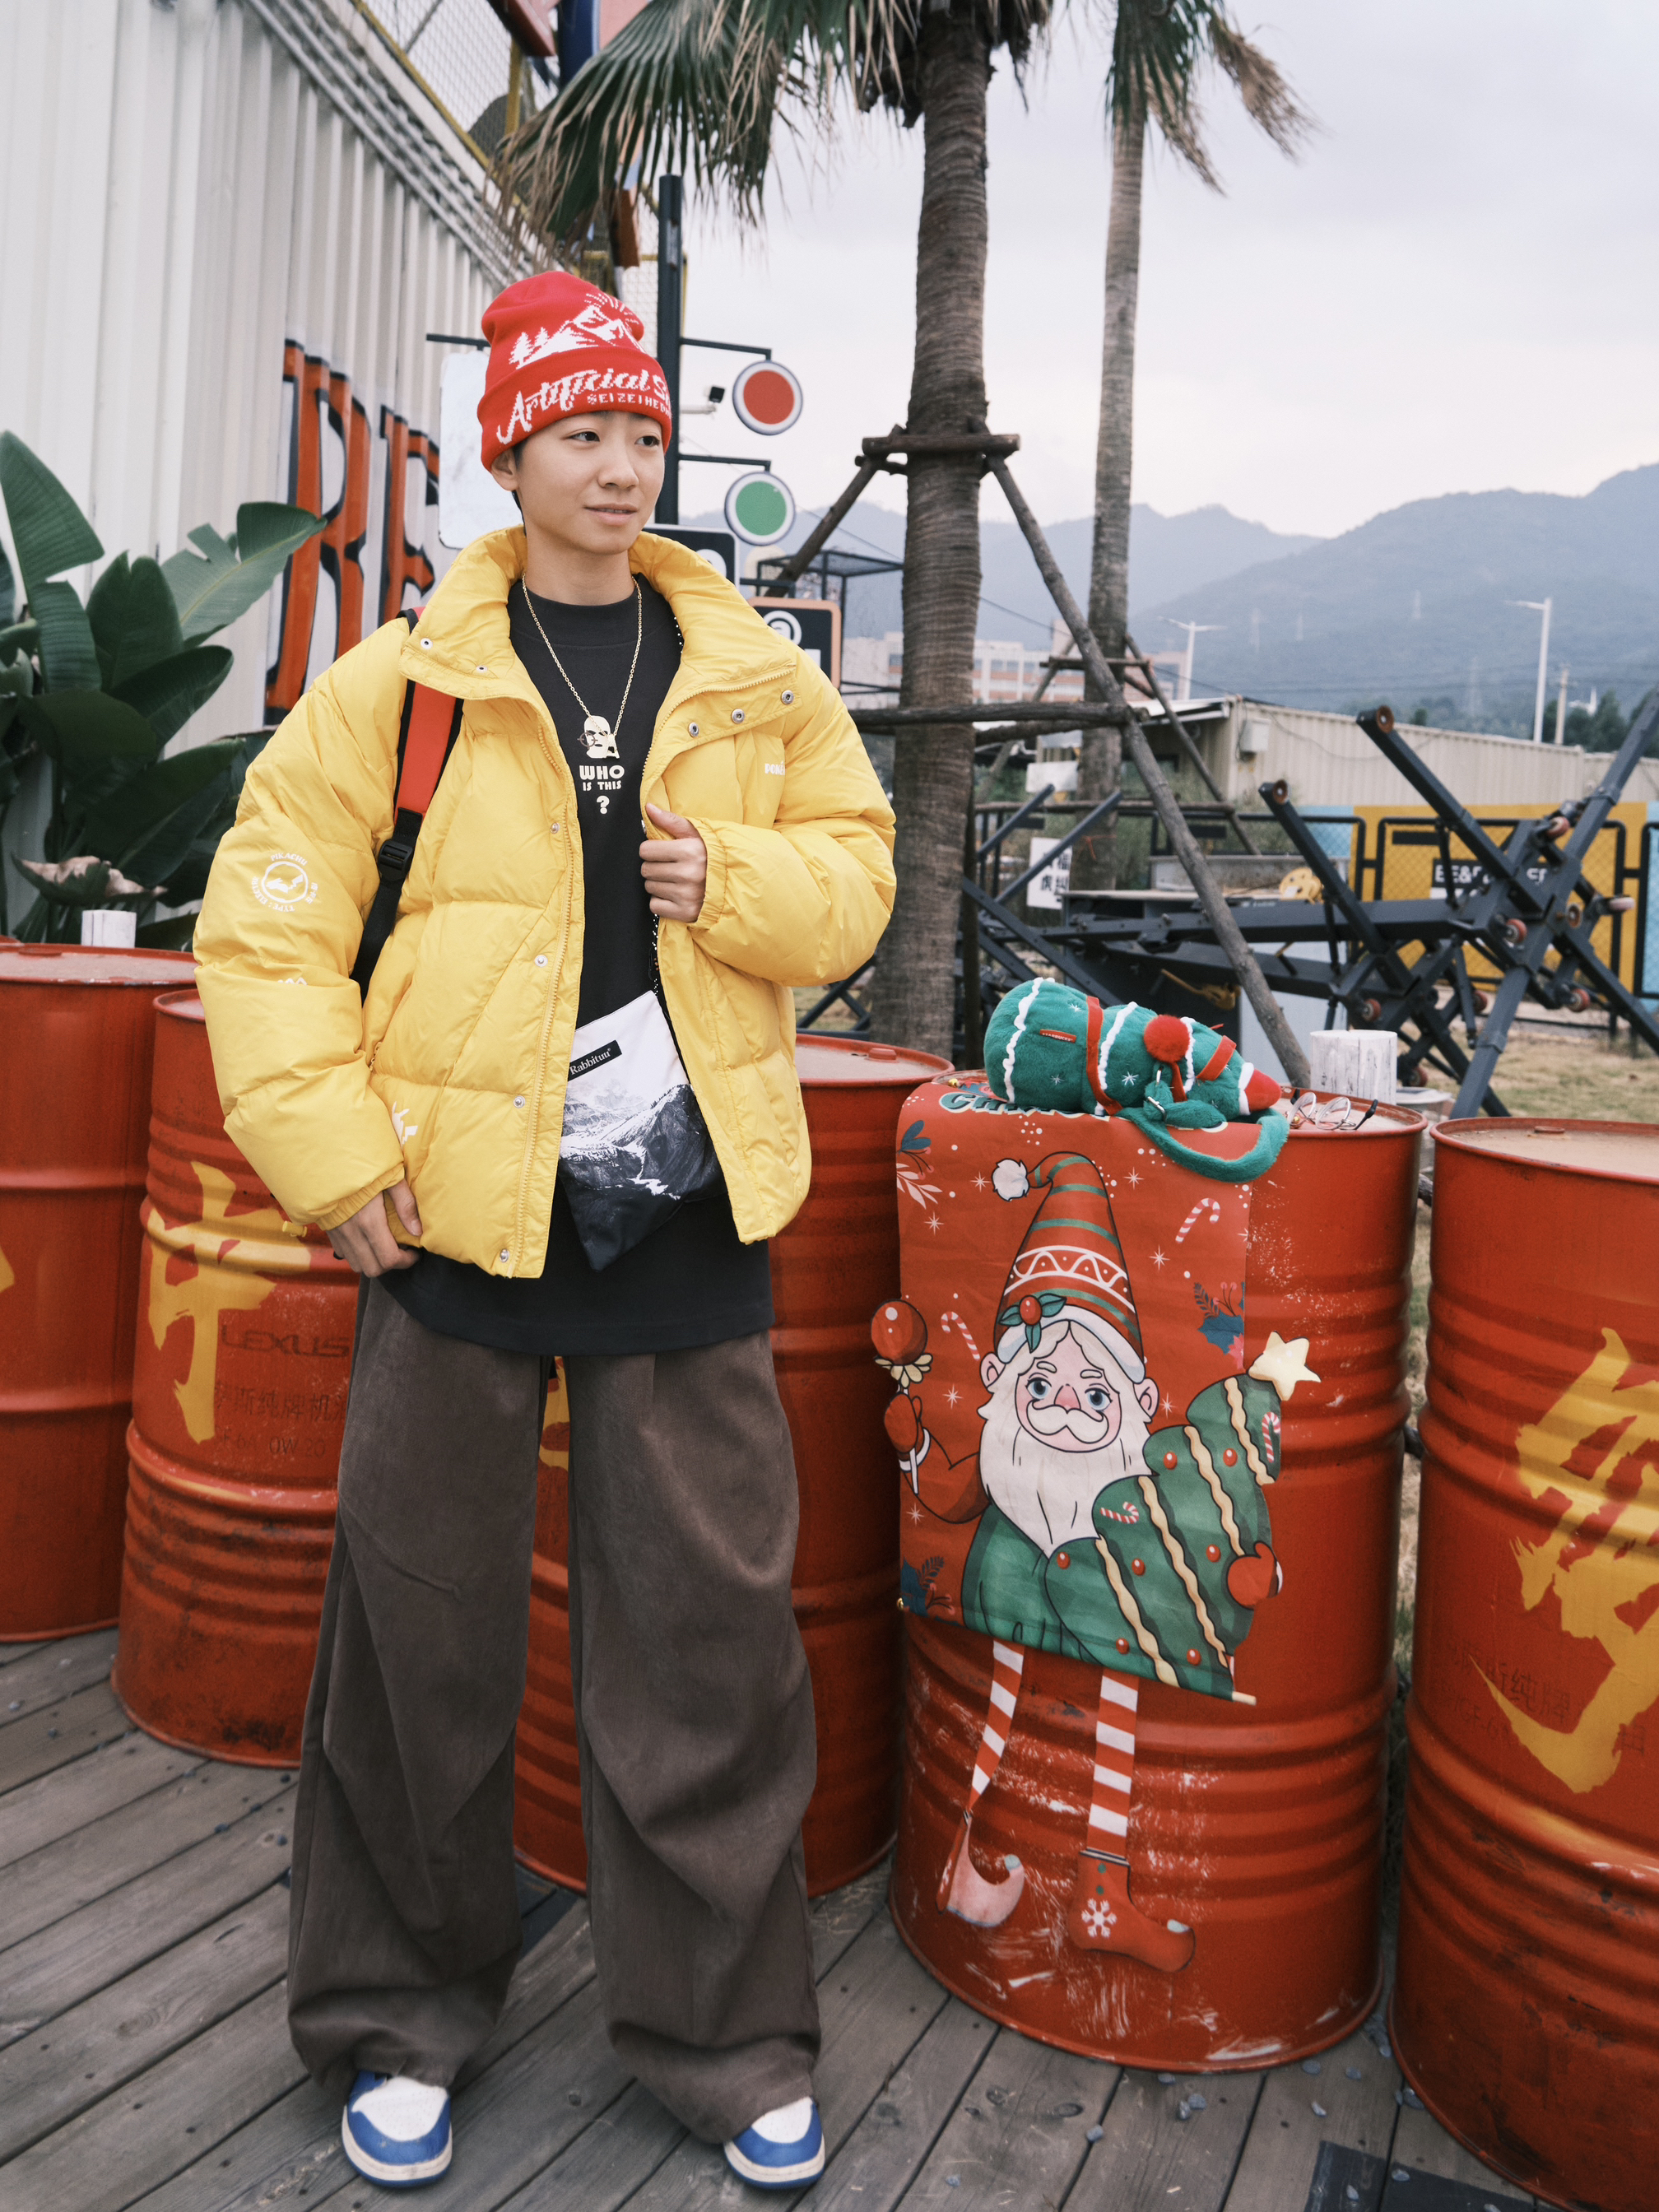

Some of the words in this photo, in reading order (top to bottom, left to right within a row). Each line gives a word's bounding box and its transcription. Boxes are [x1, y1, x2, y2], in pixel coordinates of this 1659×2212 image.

[579, 764, 625, 780] WHO
[583, 783, 592, 792] IS
[597, 780, 621, 790] THIS
[597, 795, 610, 814] ?
[271, 853, 308, 866] PIKACHU
[221, 1324, 350, 1358] LEXUS
